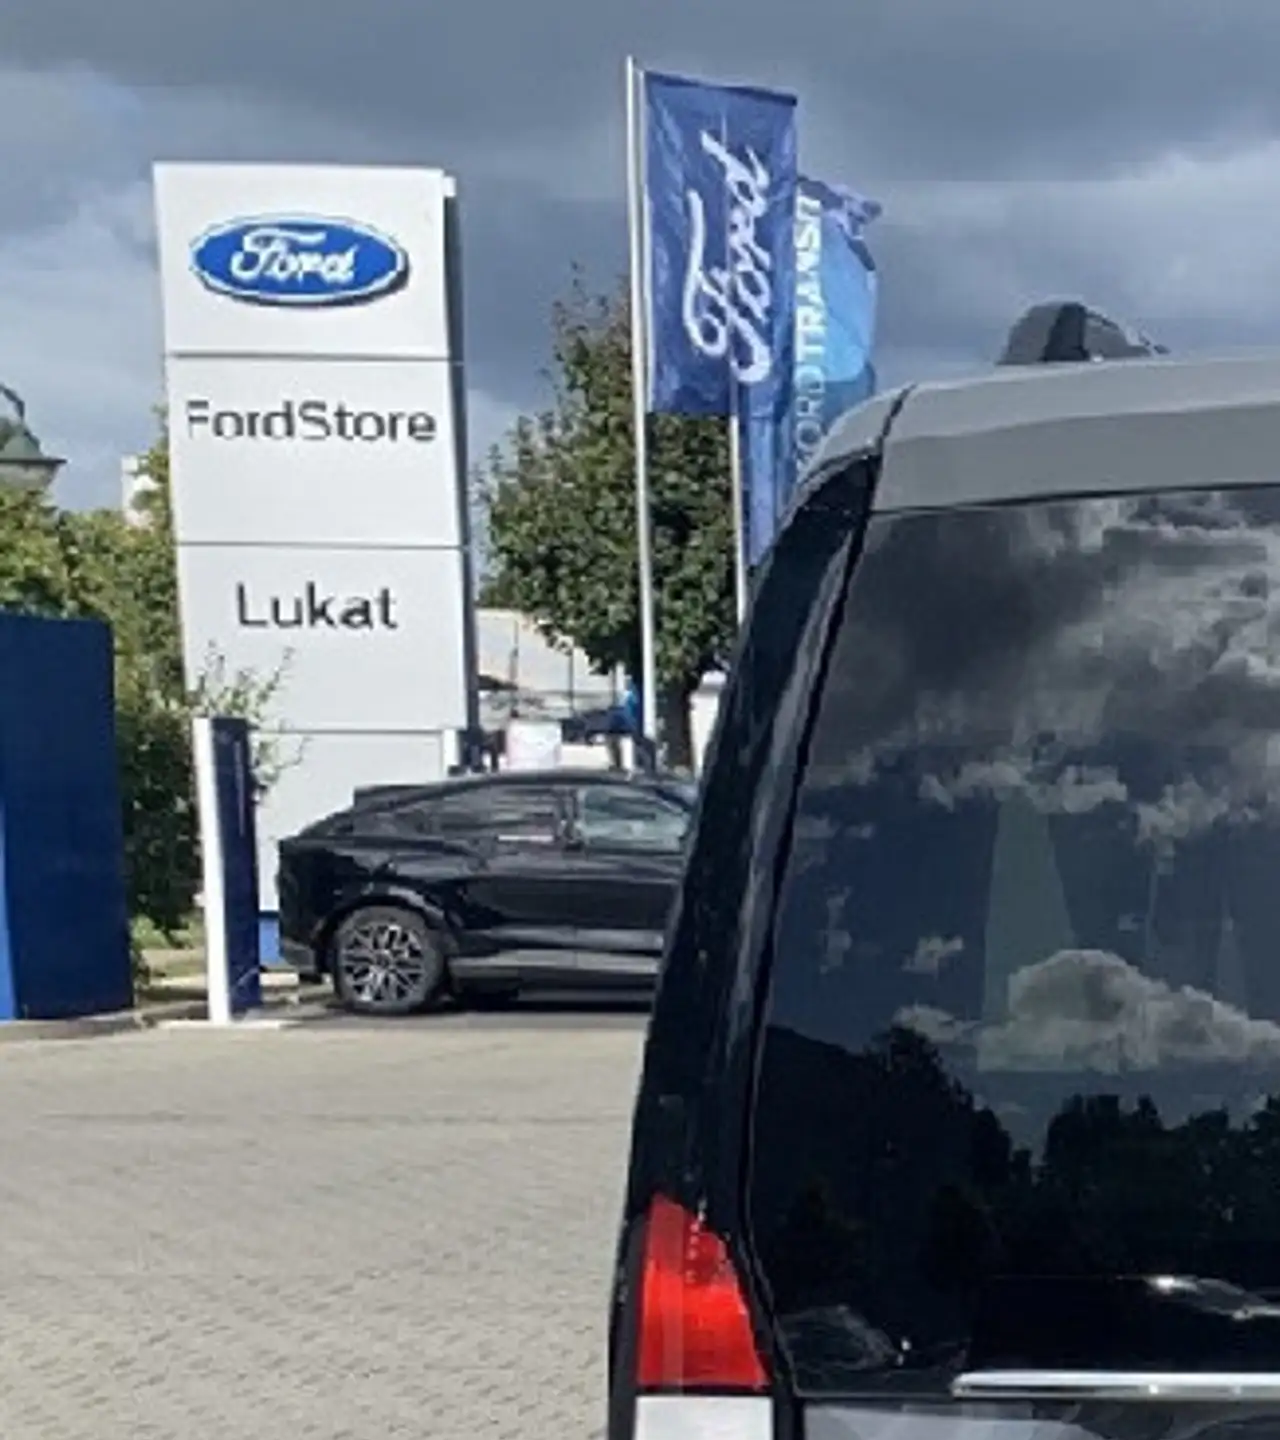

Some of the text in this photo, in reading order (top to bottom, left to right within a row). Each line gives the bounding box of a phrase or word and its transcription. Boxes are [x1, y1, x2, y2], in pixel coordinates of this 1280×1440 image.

[231, 226, 358, 284] Ford
[682, 129, 772, 383] Ford
[186, 399, 438, 442] FordStore
[236, 580, 399, 630] Lukat
